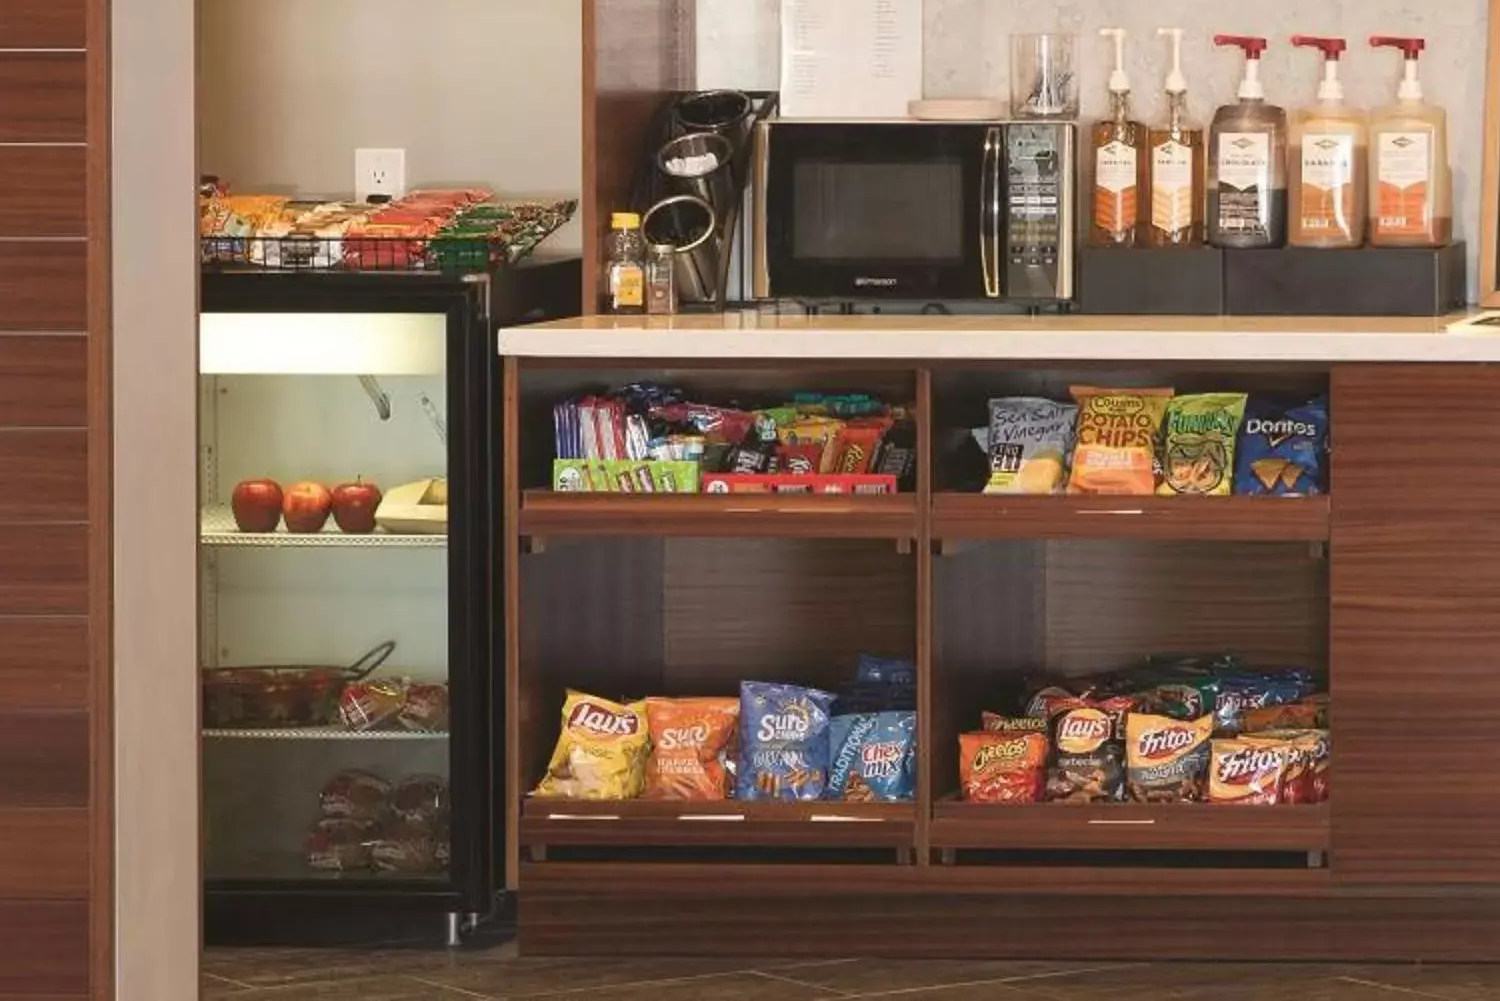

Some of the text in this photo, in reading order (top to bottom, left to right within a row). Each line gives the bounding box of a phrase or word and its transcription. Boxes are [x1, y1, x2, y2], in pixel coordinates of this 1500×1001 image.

[995, 407, 1028, 424] Sea
[1080, 413, 1150, 428] POTATO
[1003, 420, 1063, 442] Vinegar
[1078, 426, 1149, 448] CHIPS
[1246, 418, 1316, 436] Doritos
[757, 713, 809, 742] Sun
[1138, 728, 1196, 756] Fritos
[1218, 748, 1283, 782] Fritos
